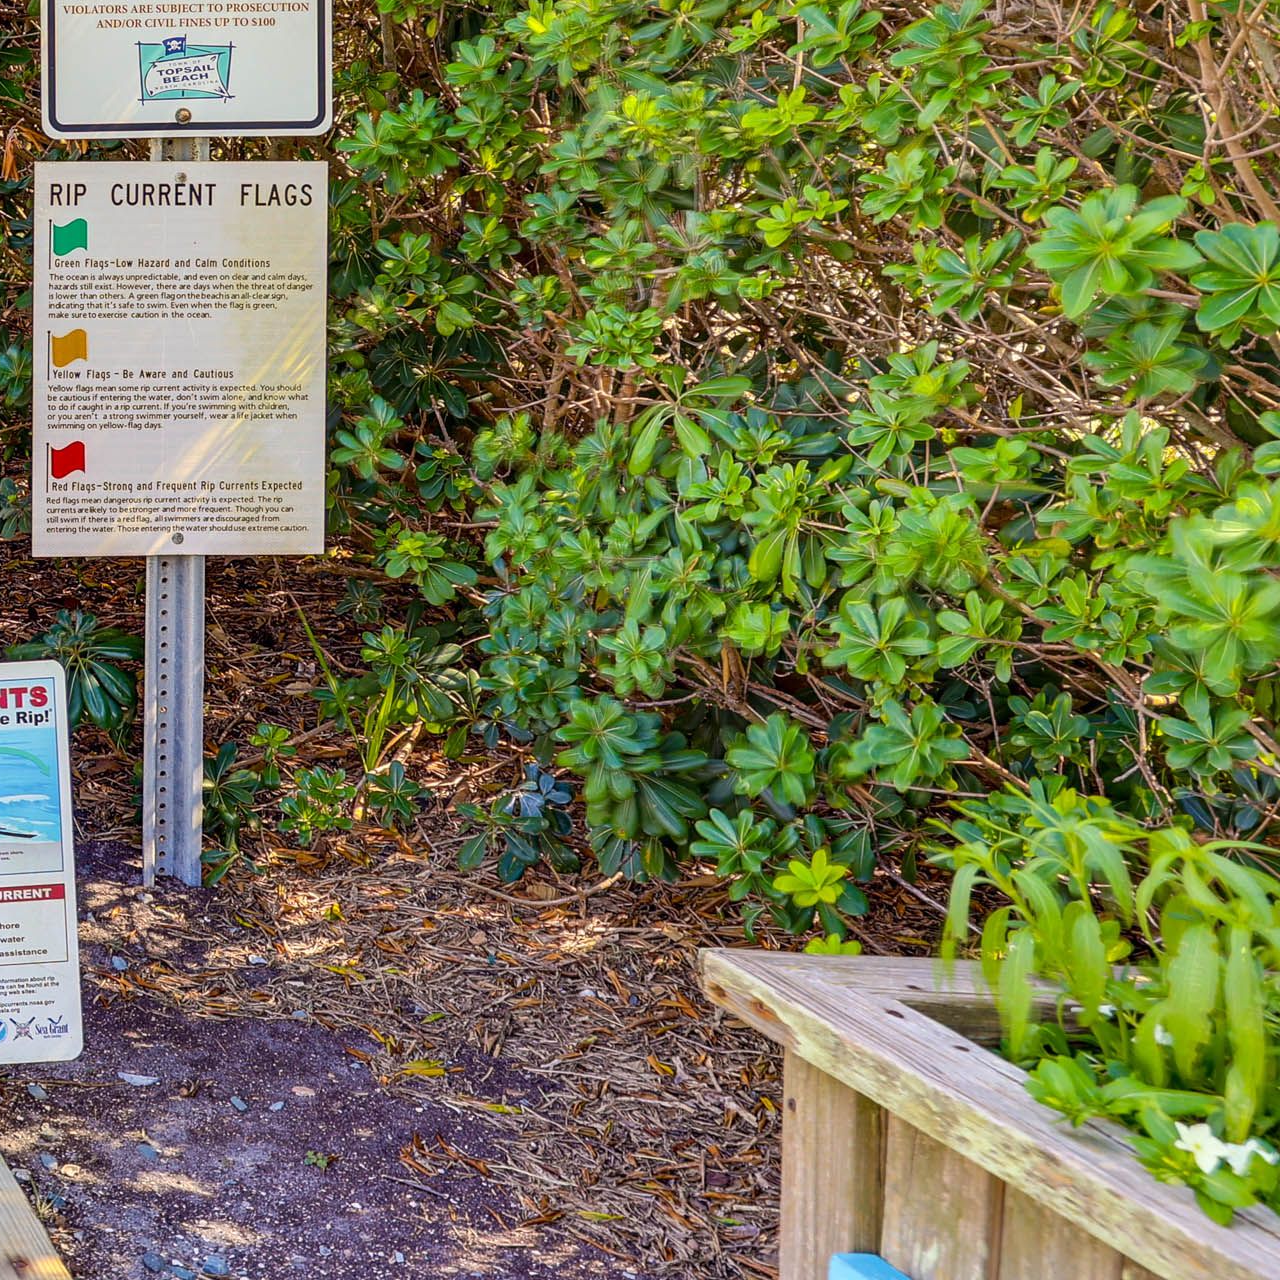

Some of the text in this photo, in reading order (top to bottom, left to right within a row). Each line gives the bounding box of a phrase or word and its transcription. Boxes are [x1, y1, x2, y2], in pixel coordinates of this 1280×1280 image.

[63, 2, 309, 14] VIOLATORS ARE SUBJECT TO PROSECUTION
[96, 18, 142, 28] AND/OR
[144, 18, 176, 28] CIVIL
[179, 17, 211, 27] FINES
[231, 17, 248, 26] TO
[251, 17, 275, 26] $100
[156, 64, 215, 76] TOPSAIL
[163, 73, 209, 83] BEACH
[50, 182, 312, 206] RIP CURRENT FLAGS
[54, 258, 80, 268] Green
[138, 258, 170, 268] Hazard
[174, 258, 190, 268] and
[195, 258, 217, 268] Calm
[222, 258, 270, 268] Conditions
[52, 368, 81, 380] Yellow
[86, 369, 110, 381] Flags
[122, 369, 134, 378] Be
[138, 369, 166, 378] Aware
[171, 369, 188, 378] and
[193, 368, 234, 378] Cautious
[51, 480, 68, 493] Red
[136, 481, 152, 491] and
[156, 480, 196, 493] Frequent
[200, 480, 215, 493] Rip
[219, 480, 259, 490] Currents
[261, 480, 302, 492] Expected
[0, 949, 47, 957] assistance
